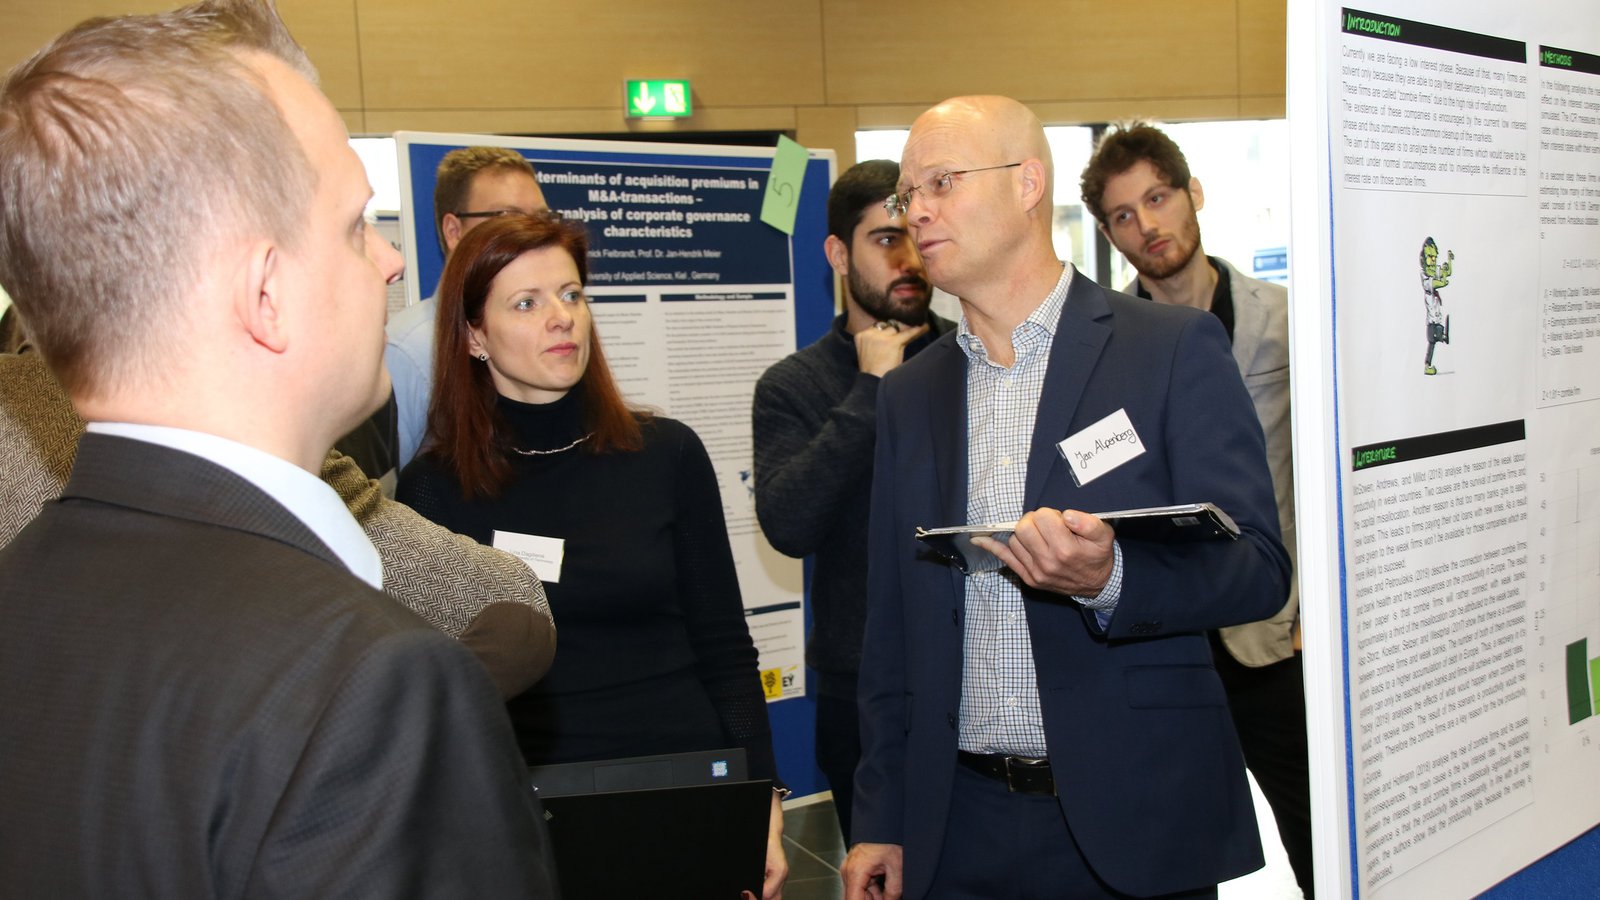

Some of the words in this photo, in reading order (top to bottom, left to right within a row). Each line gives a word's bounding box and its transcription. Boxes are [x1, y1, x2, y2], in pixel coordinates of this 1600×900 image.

[1347, 13, 1400, 36] INTRODUCTION
[1376, 53, 1385, 62] are
[1386, 52, 1402, 68] facing
[1409, 55, 1418, 67] low
[1438, 60, 1453, 74] phase.
[1455, 62, 1474, 76] Because
[1492, 71, 1505, 83] many
[1506, 70, 1517, 82] firms
[1545, 50, 1572, 66] METHODS
[1342, 64, 1359, 77] solvent
[1360, 66, 1371, 81] only
[1372, 67, 1394, 81] because
[1395, 70, 1406, 86] they
[1407, 75, 1415, 84] are
[1416, 74, 1427, 86] able
[1434, 79, 1442, 91] pay
[1443, 78, 1452, 89] their
[1488, 85, 1502, 99] raising
[1504, 89, 1512, 98] new
[1342, 81, 1357, 94] These
[1358, 83, 1371, 96] firms
[1371, 88, 1380, 97] are
[1381, 87, 1396, 99] called
[1433, 93, 1442, 105] due
[1455, 96, 1465, 110] high
[1343, 99, 1352, 111] The
[1387, 104, 1401, 117] these
[1483, 117, 1499, 127] current
[1343, 117, 1357, 132] phase
[1358, 119, 1368, 131] and
[1368, 120, 1380, 132] thus
[1420, 128, 1440, 138] common
[1441, 127, 1459, 142] cleanup
[1343, 135, 1352, 147] The
[1353, 136, 1362, 148] aim
[1370, 137, 1380, 149] this
[1380, 141, 1395, 153] paper
[1409, 141, 1427, 155] analyze
[1437, 144, 1455, 155] number
[1462, 145, 1473, 156] firms
[1474, 146, 1488, 157] which
[1489, 148, 1502, 158] would
[1503, 149, 1513, 160] have
[1365, 155, 1380, 167] under
[1382, 157, 1400, 168] normal
[1438, 160, 1447, 171] and
[535, 171, 606, 185] terminants
[609, 173, 622, 185] of
[624, 174, 689, 190] acquisition
[691, 177, 745, 190] premiums
[748, 178, 758, 189] in
[1361, 172, 1371, 184] rate
[1380, 173, 1394, 185] those
[1395, 174, 1412, 186] zombie
[1413, 175, 1426, 186] firms.
[588, 190, 694, 204] M&A-transactions
[773, 179, 794, 207] 5
[557, 208, 607, 222] nalysis
[610, 209, 623, 220] of
[626, 210, 684, 223] corporate
[686, 212, 751, 224] governance
[604, 225, 692, 238] characteristics
[587, 250, 601, 258] nick
[638, 250, 653, 258] Prof.
[655, 250, 664, 258] Dr.
[666, 250, 702, 258] Jan-Hendrik
[703, 250, 722, 258] Meier
[587, 272, 612, 282] iversity
[614, 271, 620, 280] of
[621, 271, 645, 282] Applied
[647, 272, 673, 281] Science,
[675, 271, 686, 280] Kiel
[691, 271, 720, 281] Germany
[1074, 451, 1094, 469] Jan
[1095, 428, 1137, 454] Alpenberg
[1356, 446, 1396, 468] LITERATURE
[1401, 473, 1411, 486] and
[1444, 465, 1461, 479] analyse
[1472, 462, 1486, 472] reason
[1501, 454, 1511, 466] weak
[1365, 565, 1376, 580] likely
[782, 674, 794, 687] EY
